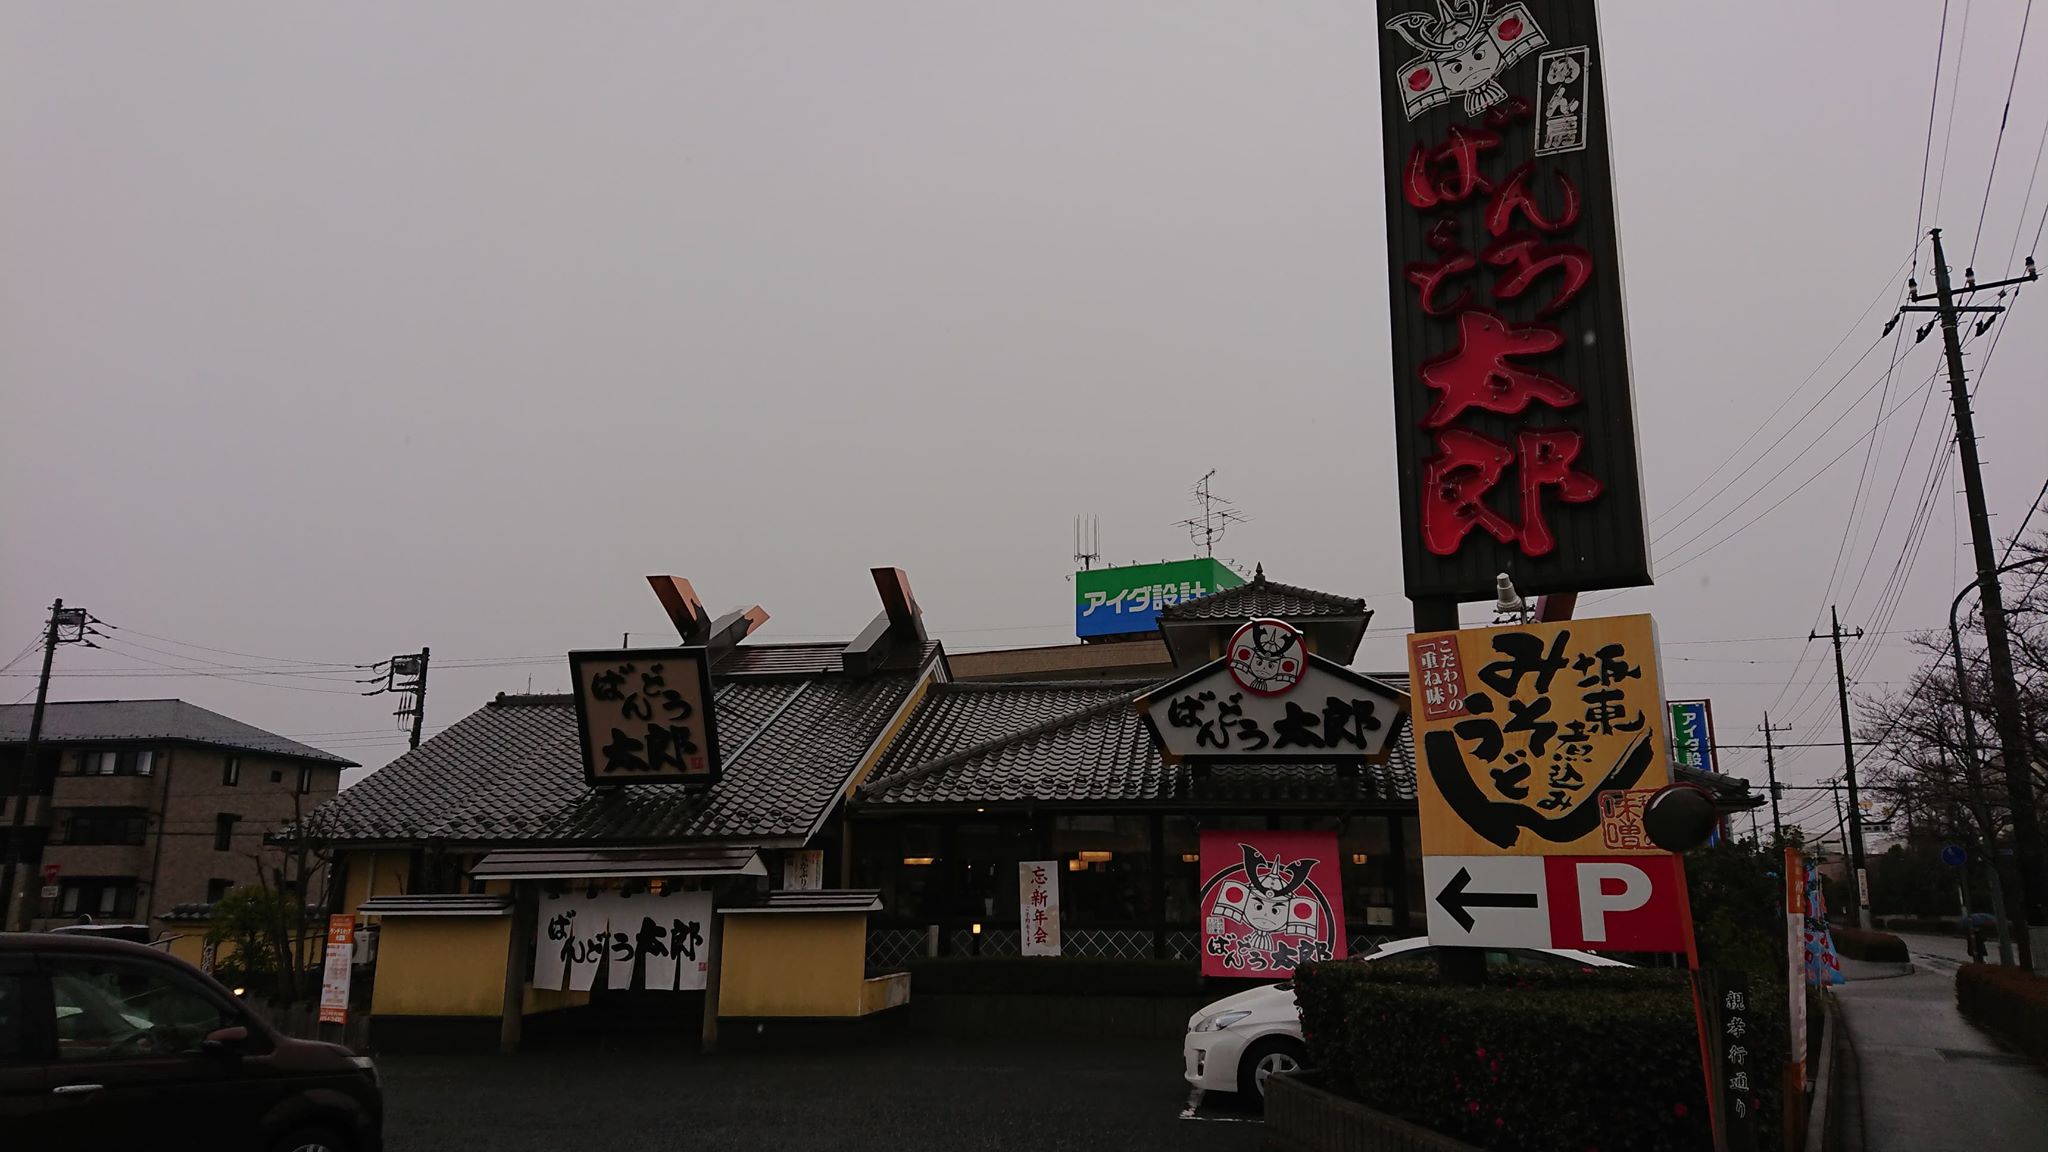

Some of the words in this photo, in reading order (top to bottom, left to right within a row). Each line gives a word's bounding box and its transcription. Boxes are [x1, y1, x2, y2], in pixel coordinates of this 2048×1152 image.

[1083, 581, 1207, 616] アイダ設計
[591, 662, 693, 722] ばんどう
[1440, 640, 1464, 711] こだわりの
[1478, 630, 1570, 757] みそ
[1572, 643, 1646, 735] 坂東
[602, 722, 697, 772] 太郎
[1168, 691, 1381, 750] ばんどう太郎
[1576, 863, 1653, 942] P
[548, 909, 704, 963] ばんどう太郎
[1725, 989, 1750, 1119] 親孝行通り
